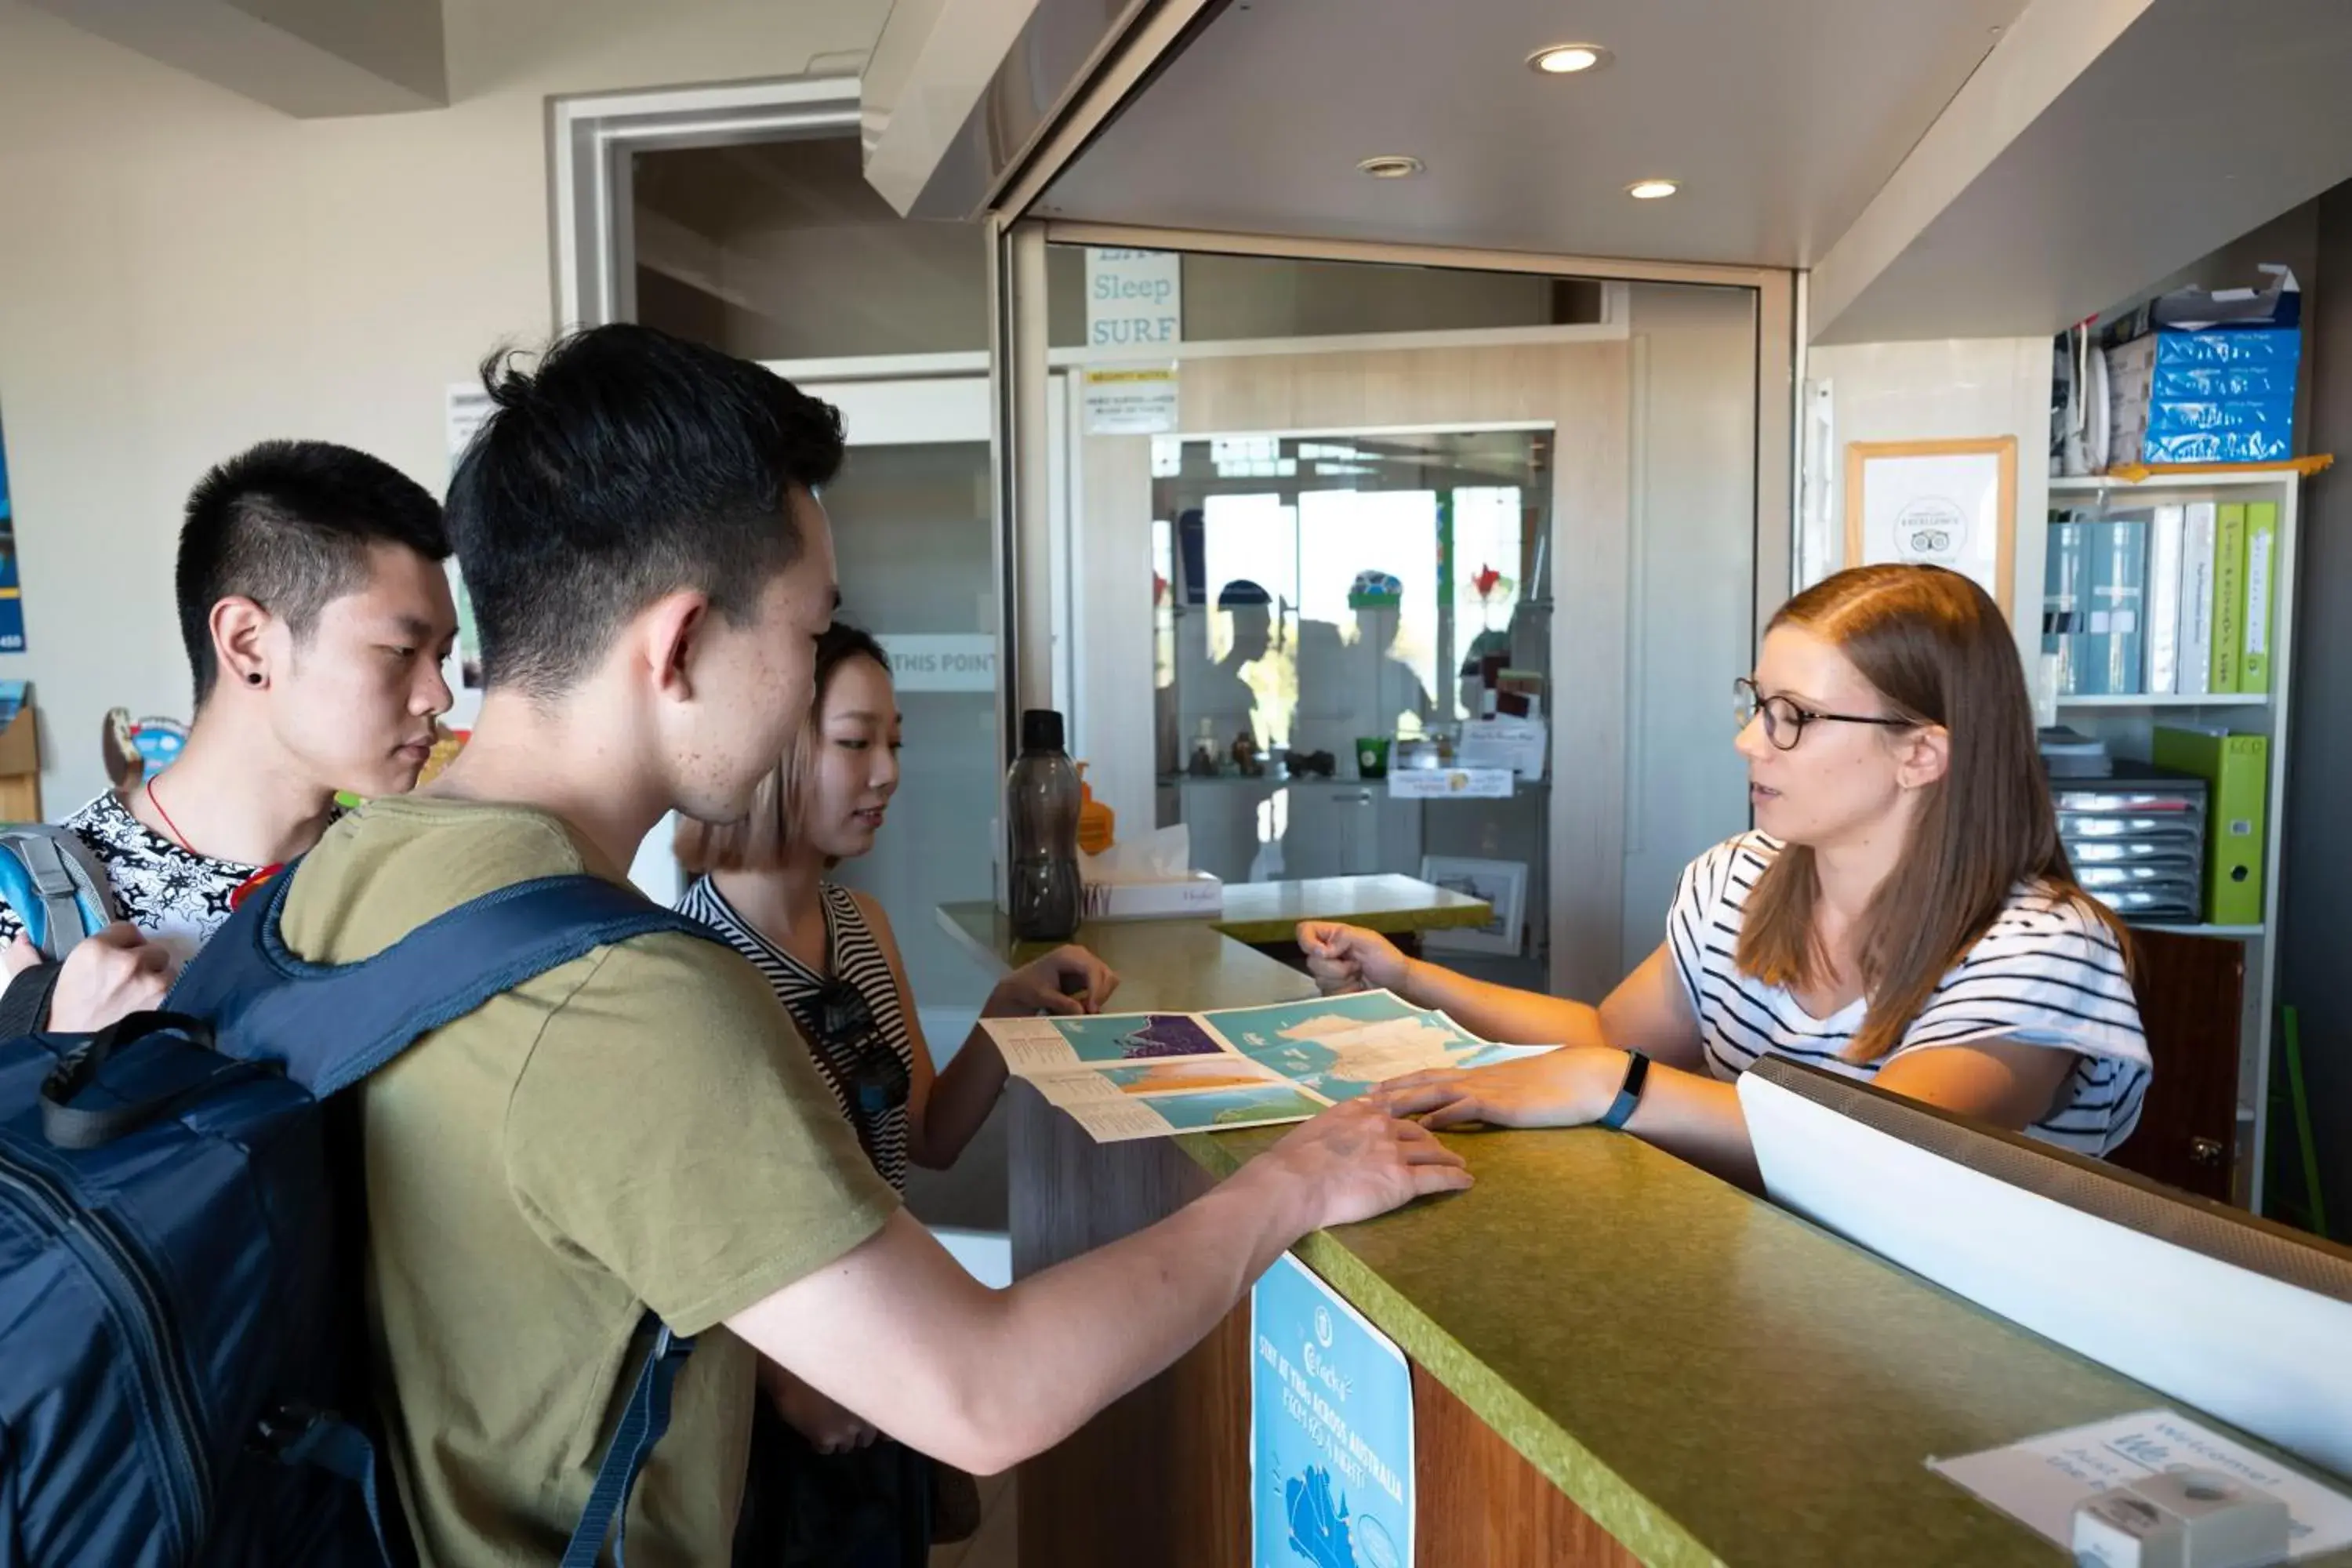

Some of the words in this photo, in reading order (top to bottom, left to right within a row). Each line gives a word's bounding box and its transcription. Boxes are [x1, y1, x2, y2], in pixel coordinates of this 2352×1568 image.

[1094, 274, 1171, 305] Sleep
[1094, 316, 1176, 344] SURF
[893, 654, 935, 673] THIS
[942, 653, 996, 673] POINT
[1259, 1334, 1278, 1368] STAY
[1313, 1391, 1347, 1446] ACROSS
[1349, 1430, 1403, 1505] AUSTRALIA
[1283, 1385, 1308, 1429] FROM
